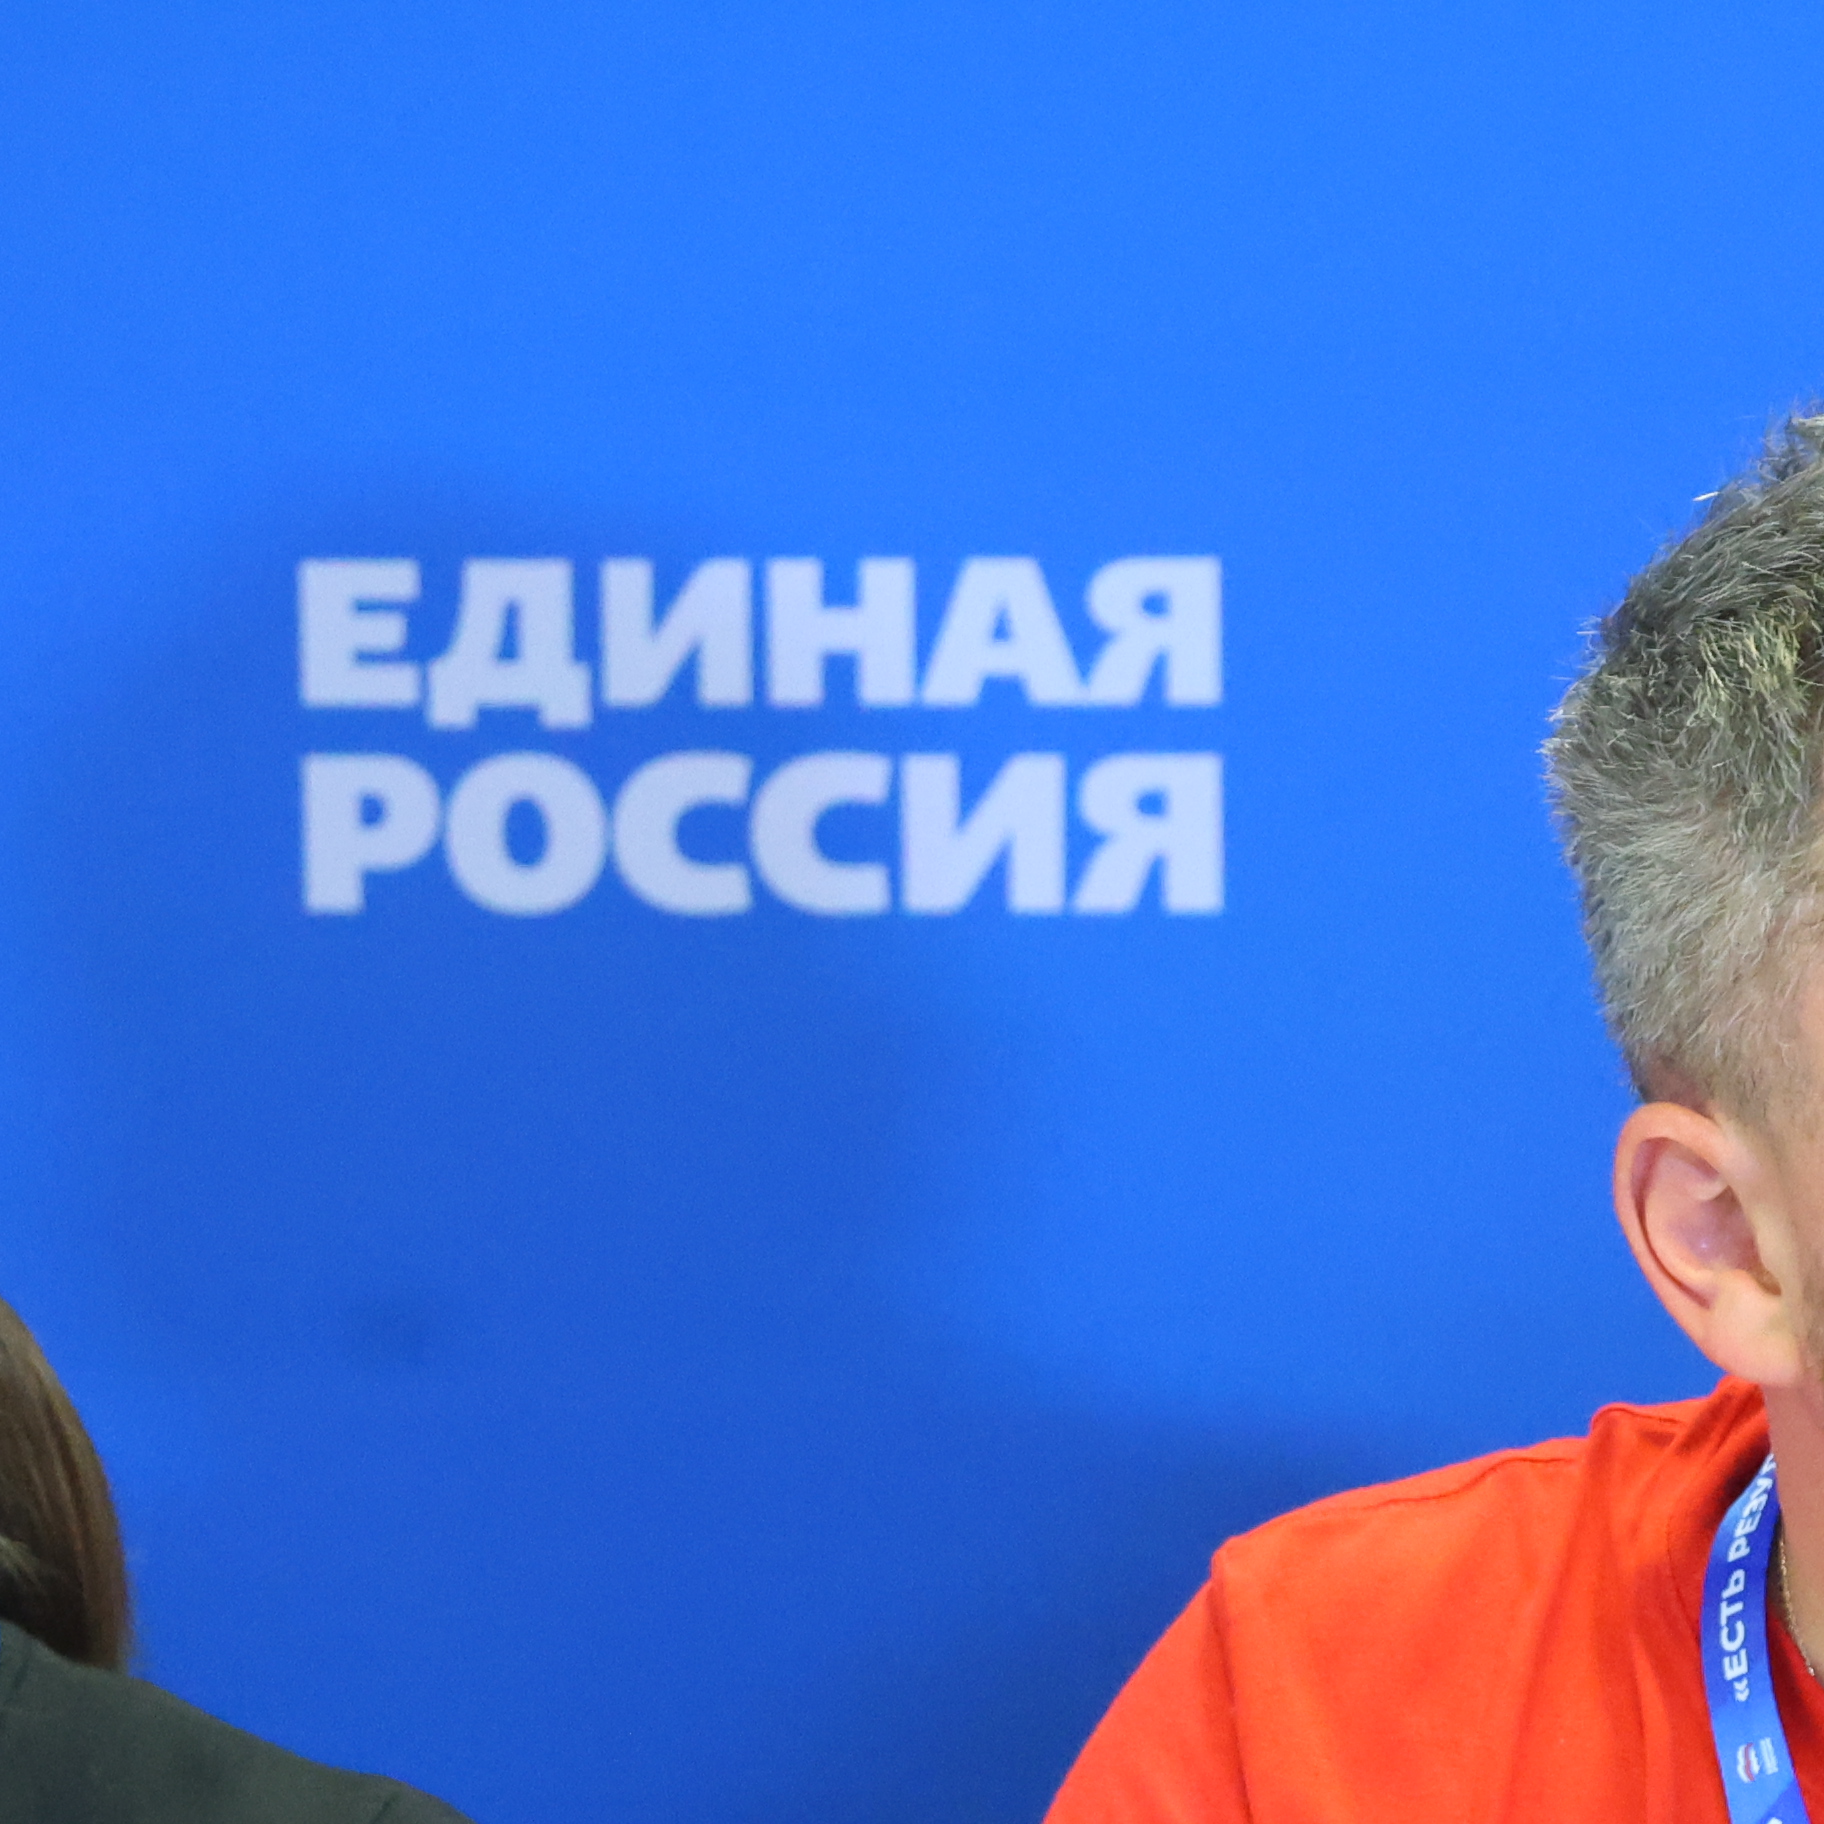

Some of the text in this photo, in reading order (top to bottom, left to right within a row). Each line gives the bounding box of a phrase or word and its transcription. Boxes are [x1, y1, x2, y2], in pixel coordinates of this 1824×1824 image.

[296, 553, 1224, 731] ЕДИНАЯ
[300, 749, 1225, 916] РОССИЯ
[1719, 1568, 1750, 1703] «ЕСТЬ
